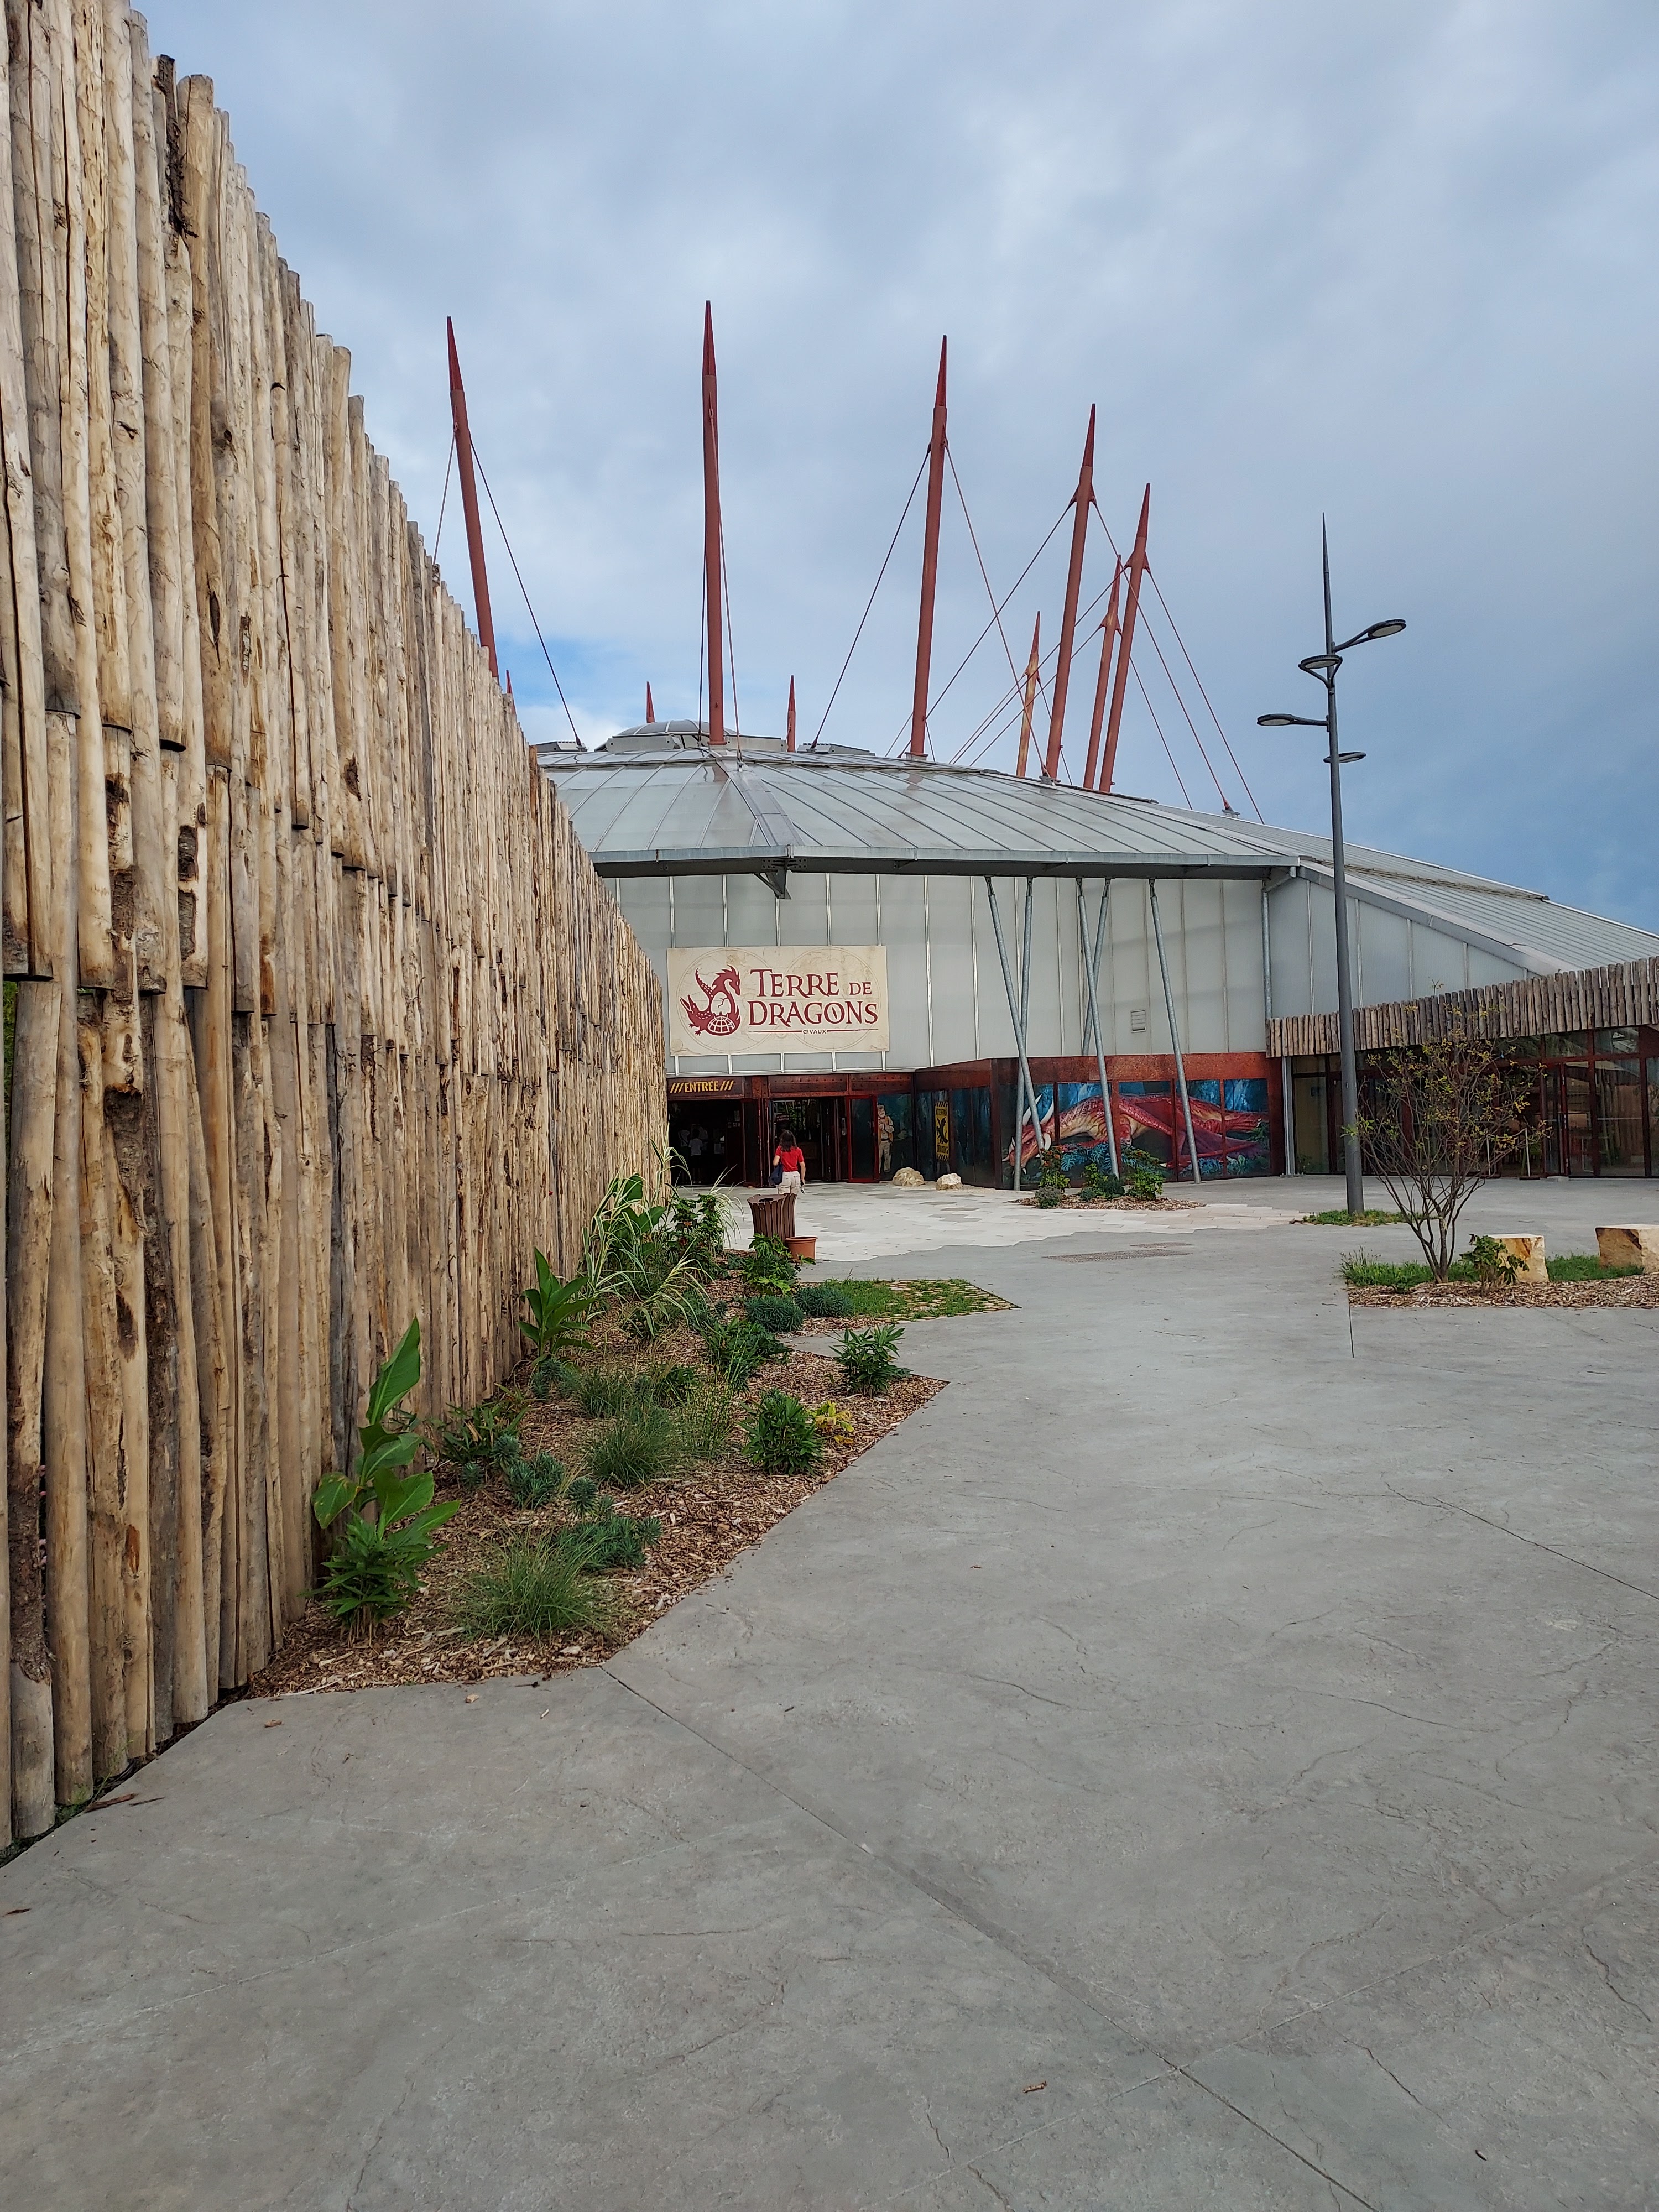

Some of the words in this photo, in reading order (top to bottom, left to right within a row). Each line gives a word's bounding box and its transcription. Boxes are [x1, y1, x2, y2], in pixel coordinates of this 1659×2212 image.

[749, 969, 839, 998] TERRE
[849, 982, 872, 995] DE
[747, 1000, 879, 1027] DRAGONS
